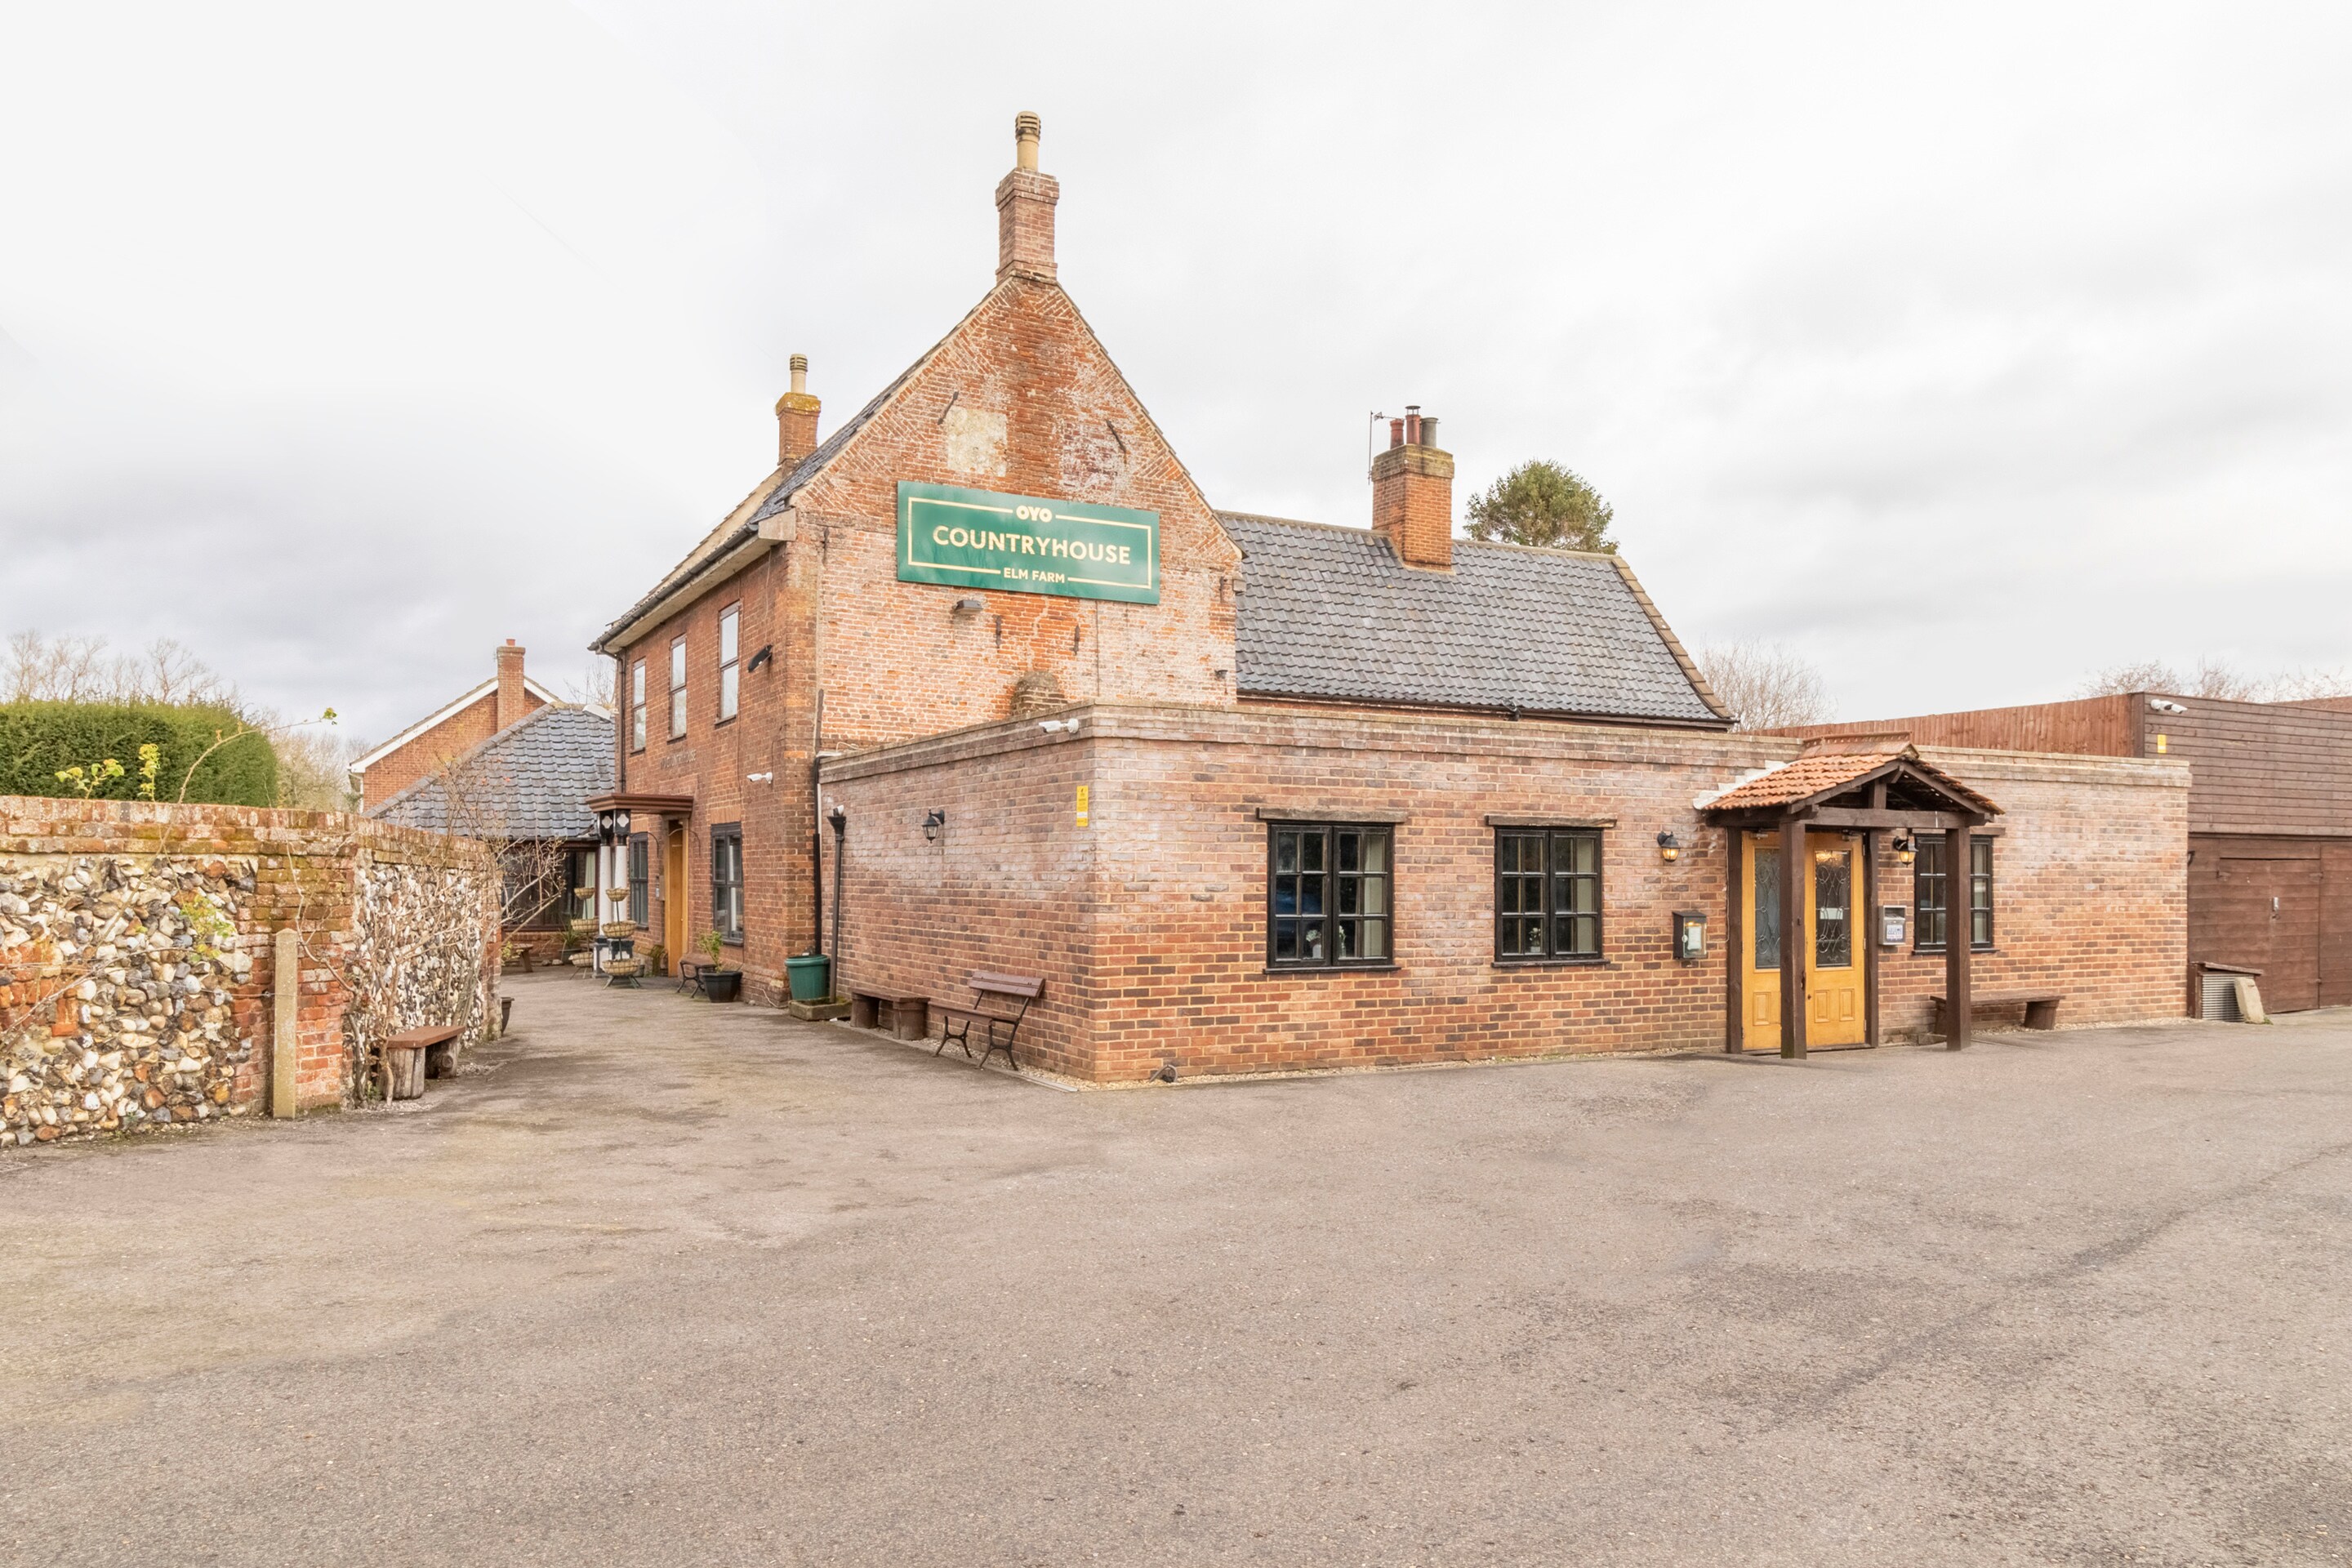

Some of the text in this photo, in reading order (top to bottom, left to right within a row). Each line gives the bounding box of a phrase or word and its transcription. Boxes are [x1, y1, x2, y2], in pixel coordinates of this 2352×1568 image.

[1016, 505, 1053, 523] OYO
[933, 525, 1131, 565] COUNTRYHOUSE
[1004, 567, 1065, 584] ELM FARM
